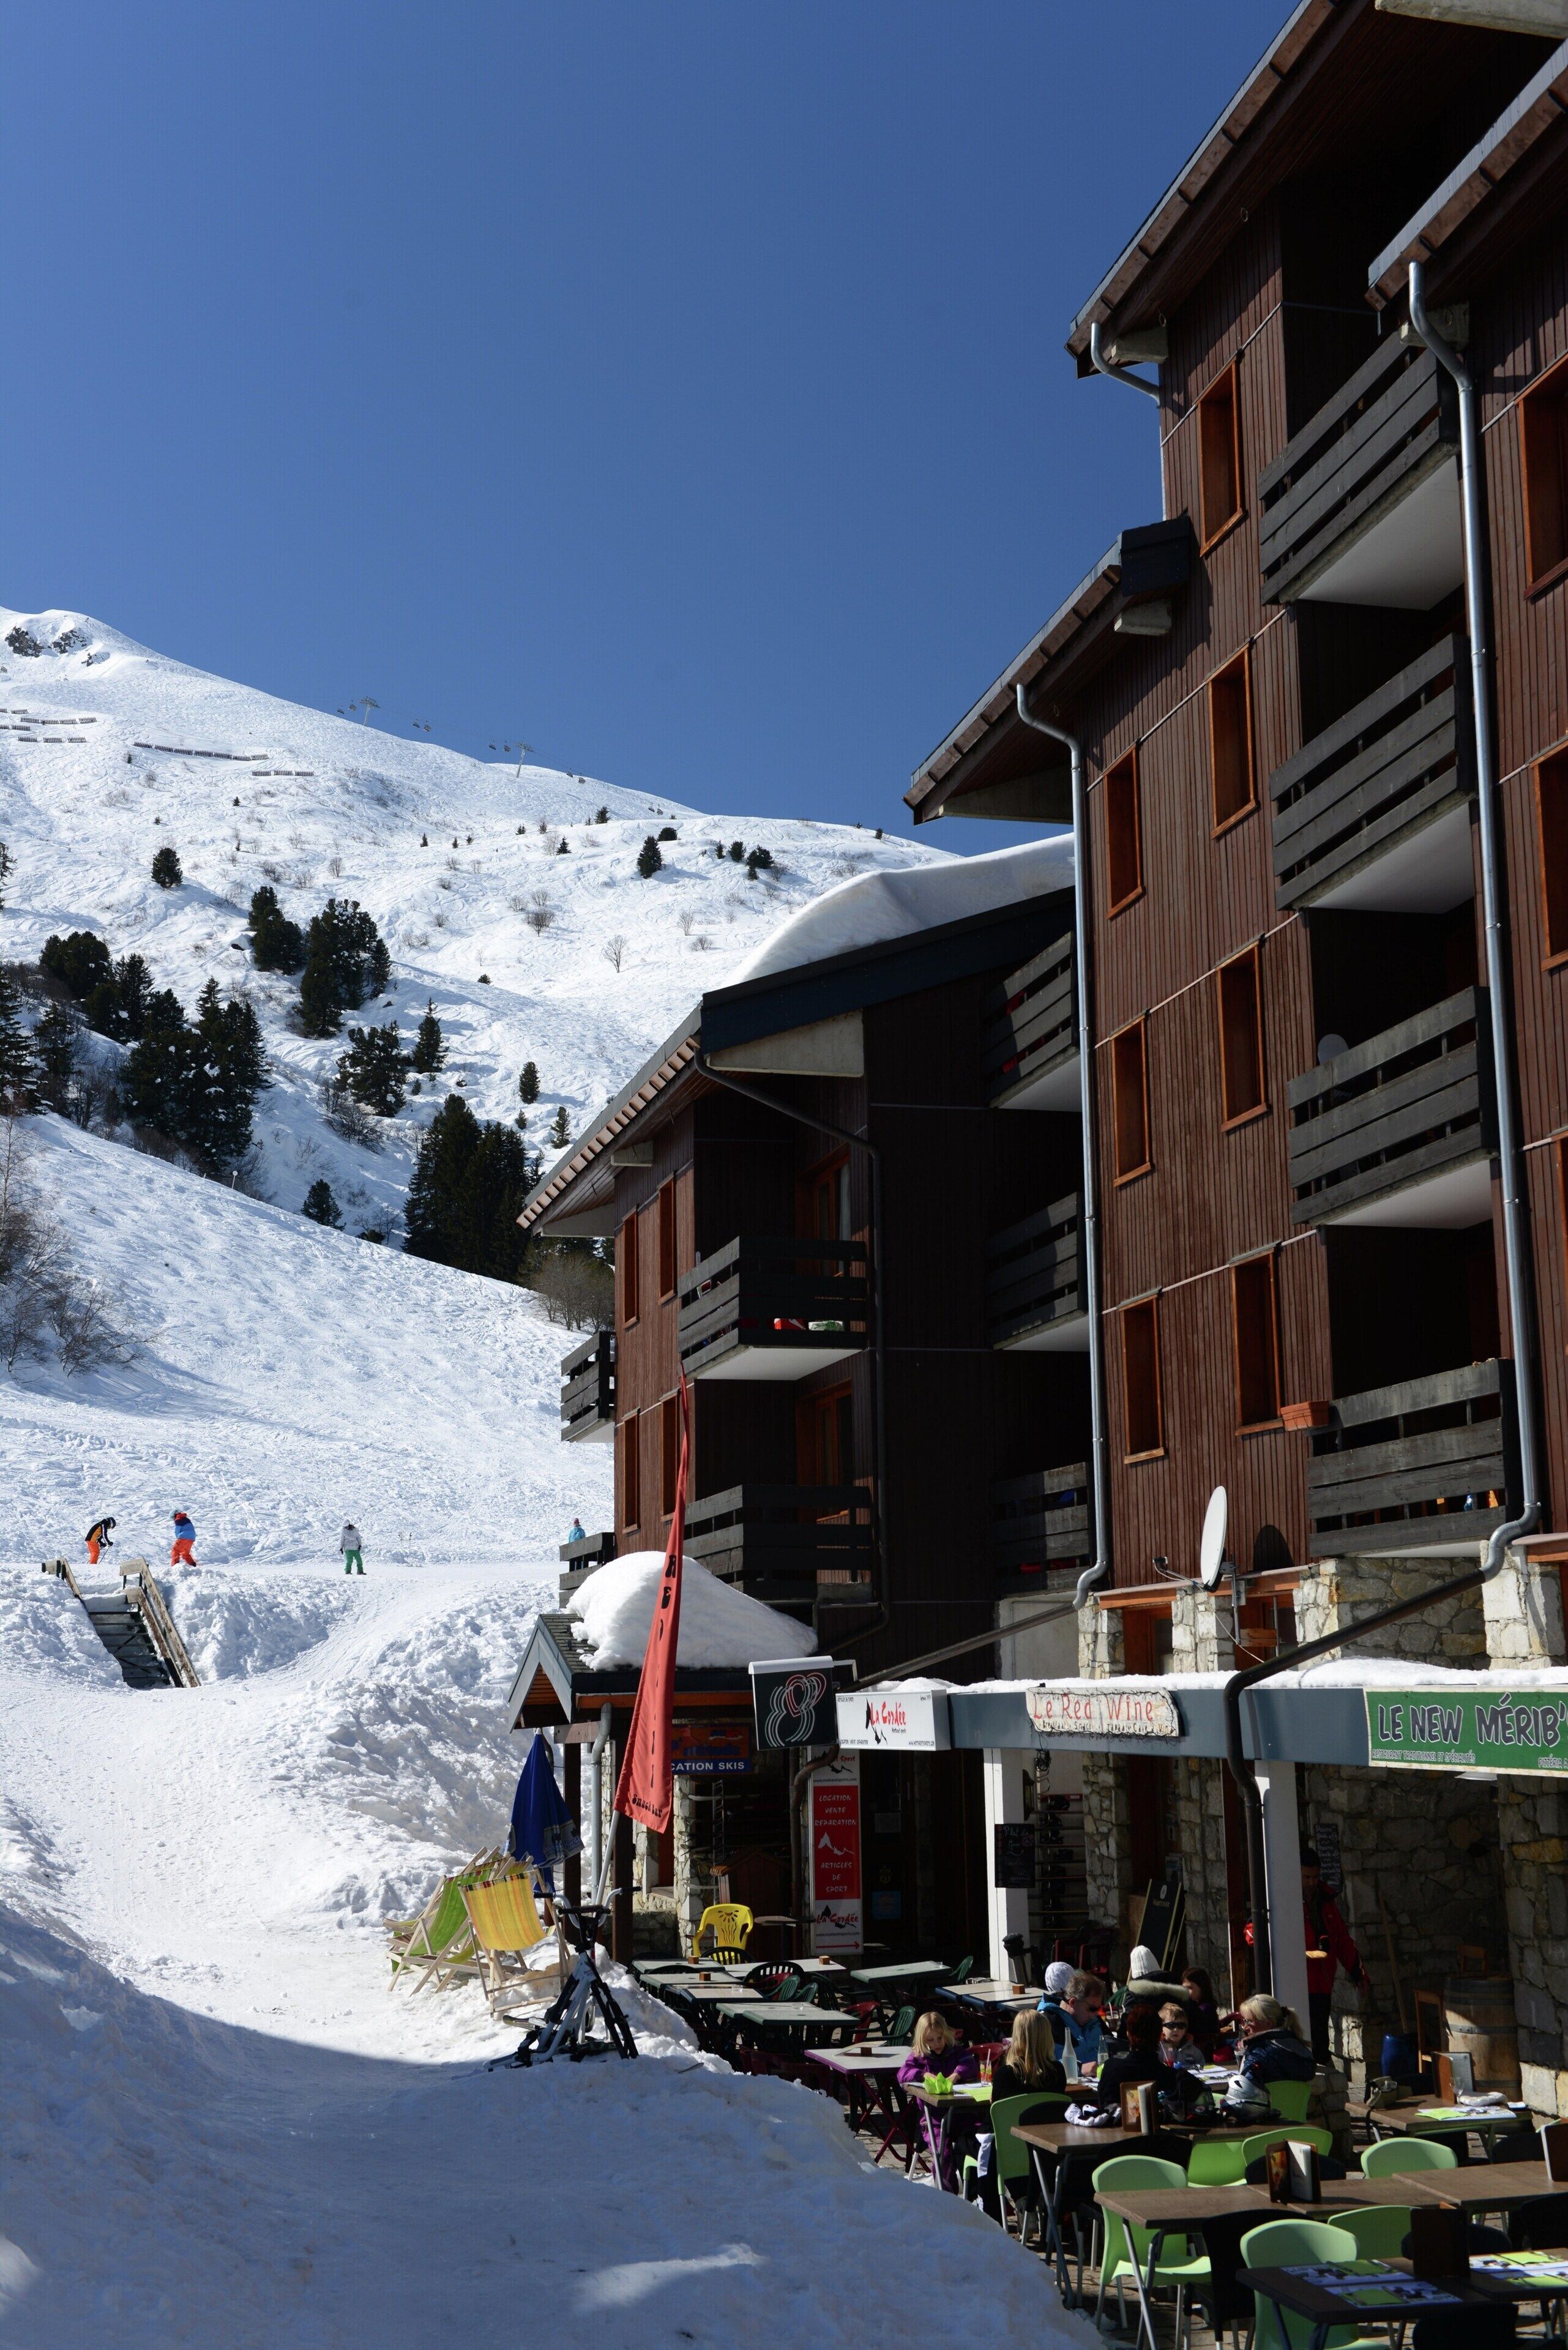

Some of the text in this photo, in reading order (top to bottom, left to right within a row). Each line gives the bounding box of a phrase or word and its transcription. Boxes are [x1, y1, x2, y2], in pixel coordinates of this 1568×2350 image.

[870, 1701, 906, 1726] La Cordée
[1034, 1693, 1152, 1722] Le Red Wine
[1378, 1692, 1568, 1747] LE NEW MÉRIB'
[1372, 1748, 1476, 1764] RESTAURANT TRADITIONNEL ET SPÉCIALITÉS
[1538, 1753, 1562, 1769] PIZZÉRIA
[632, 1794, 651, 1811] Snack
[816, 1913, 859, 1924] La Cordée
